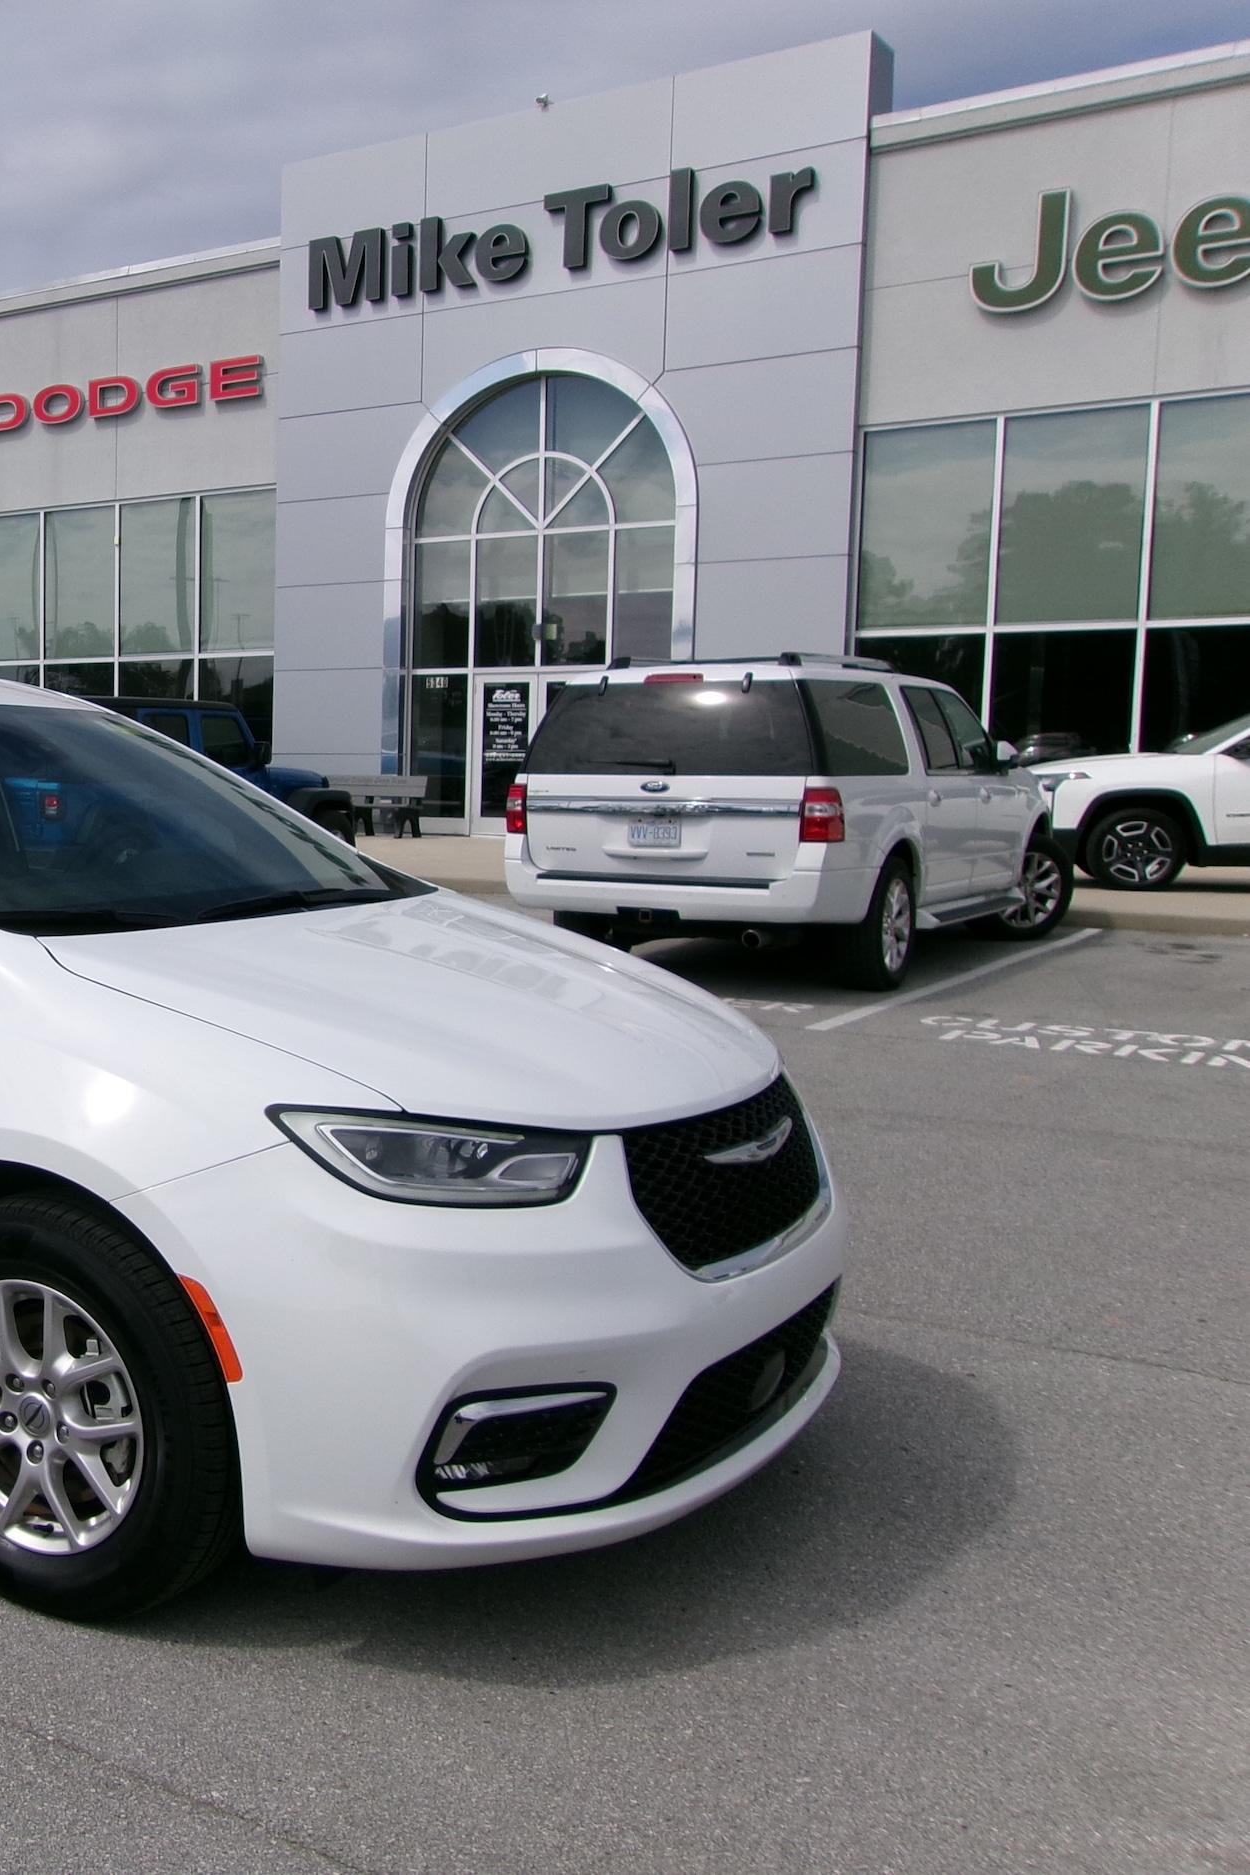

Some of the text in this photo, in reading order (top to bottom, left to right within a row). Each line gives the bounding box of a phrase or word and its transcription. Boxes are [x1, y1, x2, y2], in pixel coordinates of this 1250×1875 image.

[307, 166, 817, 312] Mike Toler
[968, 186, 1250, 314] Jee
